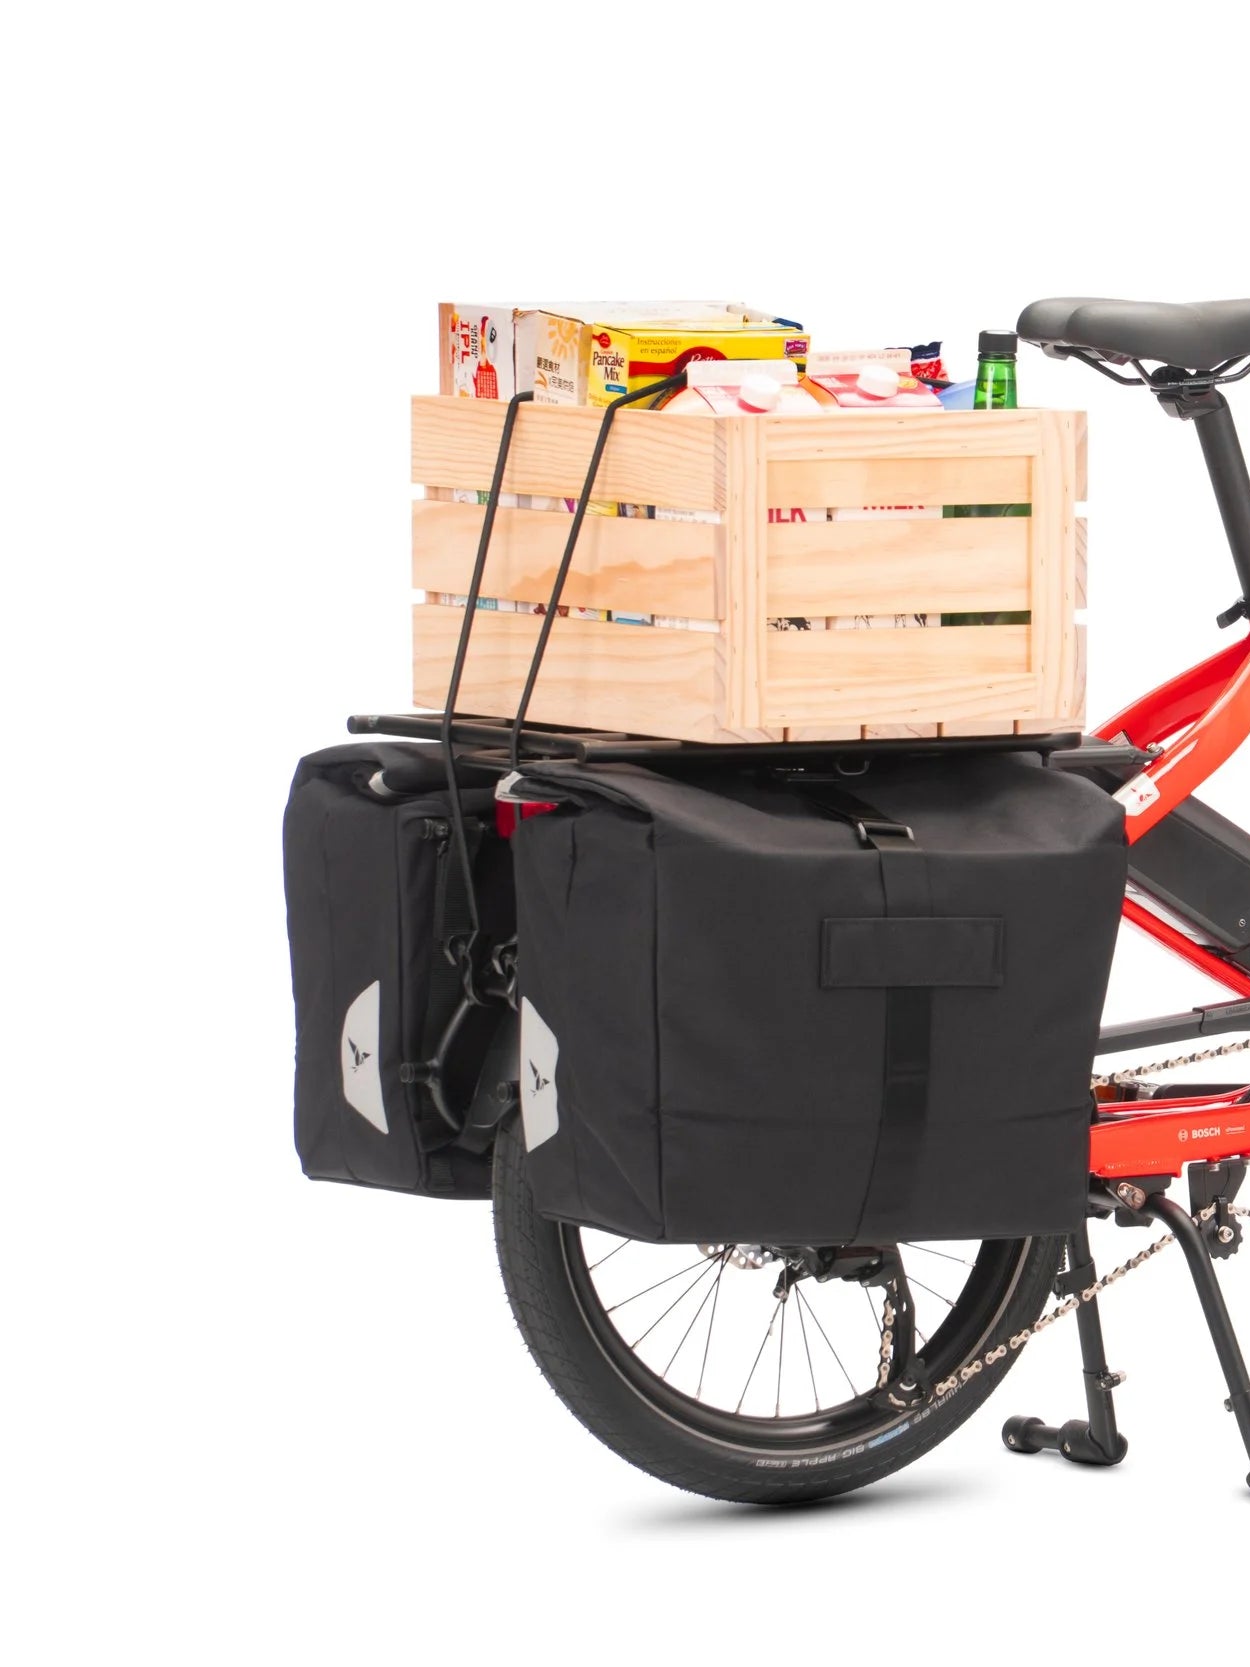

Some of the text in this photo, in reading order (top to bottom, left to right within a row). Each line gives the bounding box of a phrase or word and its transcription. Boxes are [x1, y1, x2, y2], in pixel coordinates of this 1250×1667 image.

[460, 321, 470, 364] IPL
[592, 351, 625, 368] Pancake
[603, 366, 620, 382] Mix
[1191, 1126, 1221, 1139] BOSCH
[842, 1444, 866, 1459] BIG
[791, 1455, 838, 1468] APPLE
